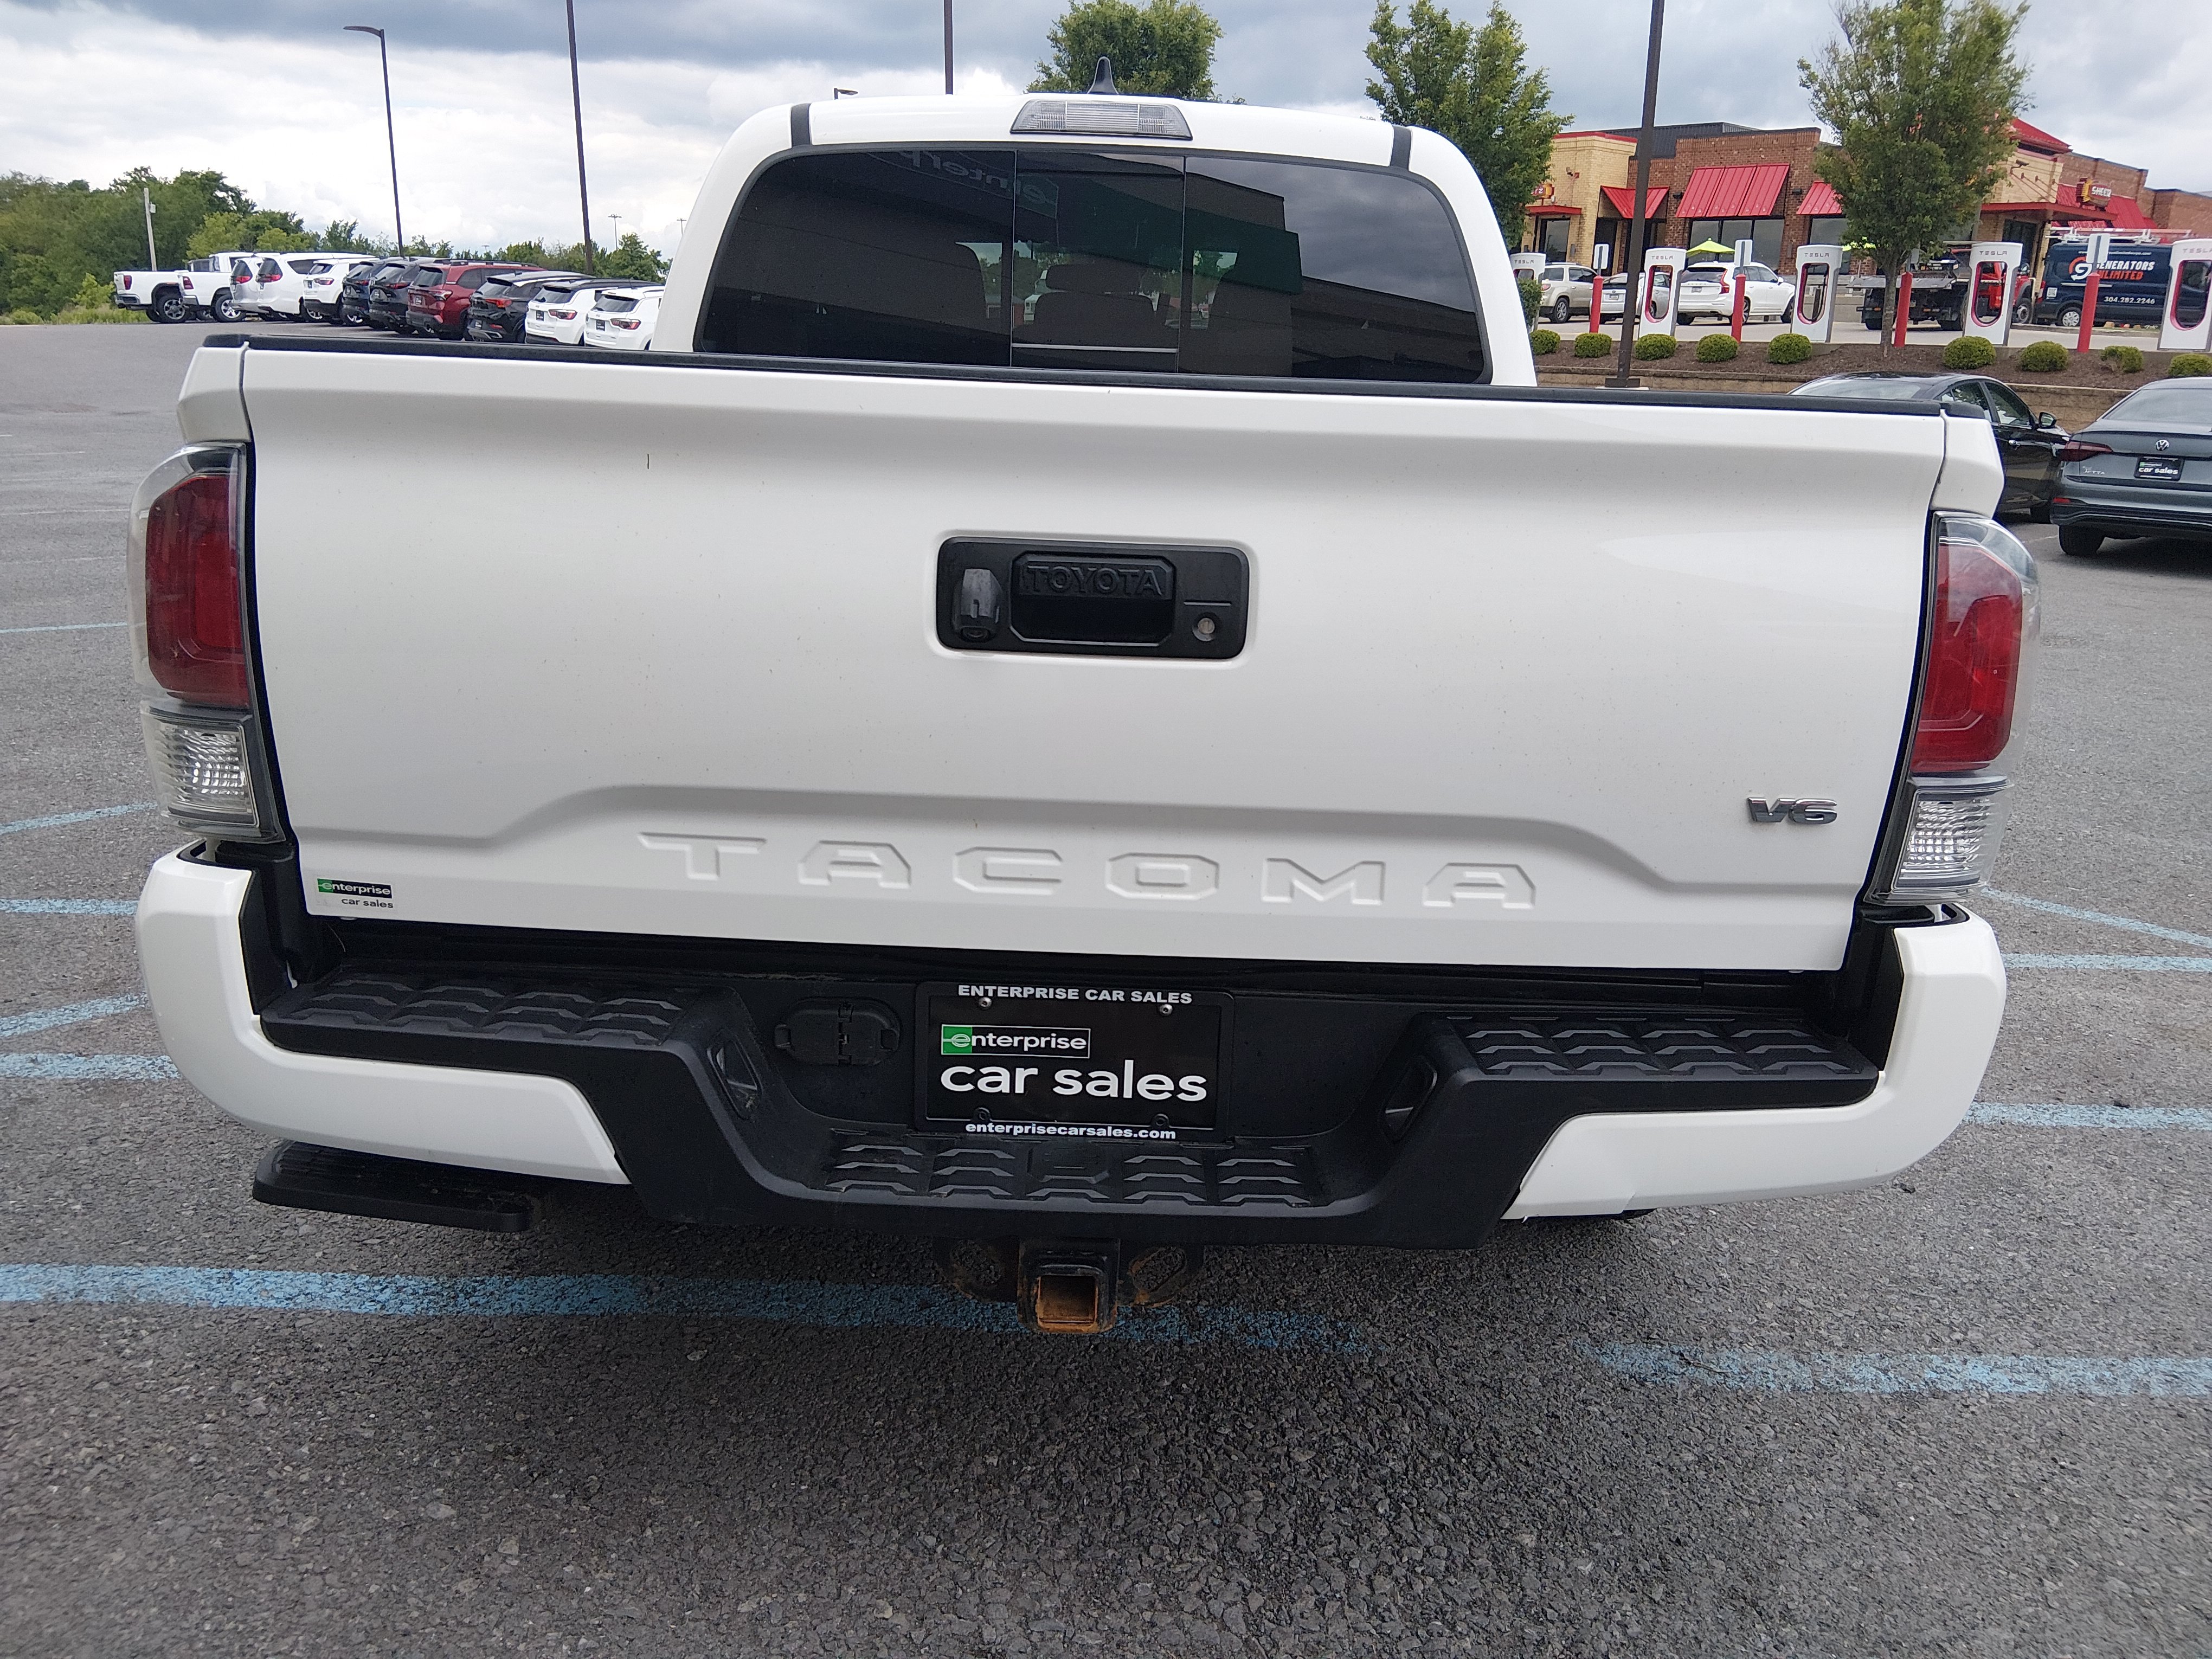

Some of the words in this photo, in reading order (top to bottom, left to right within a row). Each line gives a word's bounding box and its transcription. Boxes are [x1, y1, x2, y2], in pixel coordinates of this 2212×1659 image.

[2097, 260, 2156, 271] ENERATORS
[2097, 270, 2144, 280] NLIMITED
[2104, 296, 2156, 304] 304.282.2246
[1026, 565, 1163, 596] TOYOTA
[1747, 798, 1837, 825] V6
[639, 832, 1536, 909] TACOMA
[323, 882, 391, 895] enterprise
[363, 899, 394, 909] sales
[958, 985, 1079, 1000] ENTERPRISE
[1085, 989, 1125, 1002] CAR
[1131, 991, 1192, 1004] SALES
[950, 1032, 1087, 1051] enterprise
[941, 1065, 1038, 1094] car
[1052, 1059, 1207, 1102] sales
[965, 1122, 1176, 1140] enterprisecarsales.com
